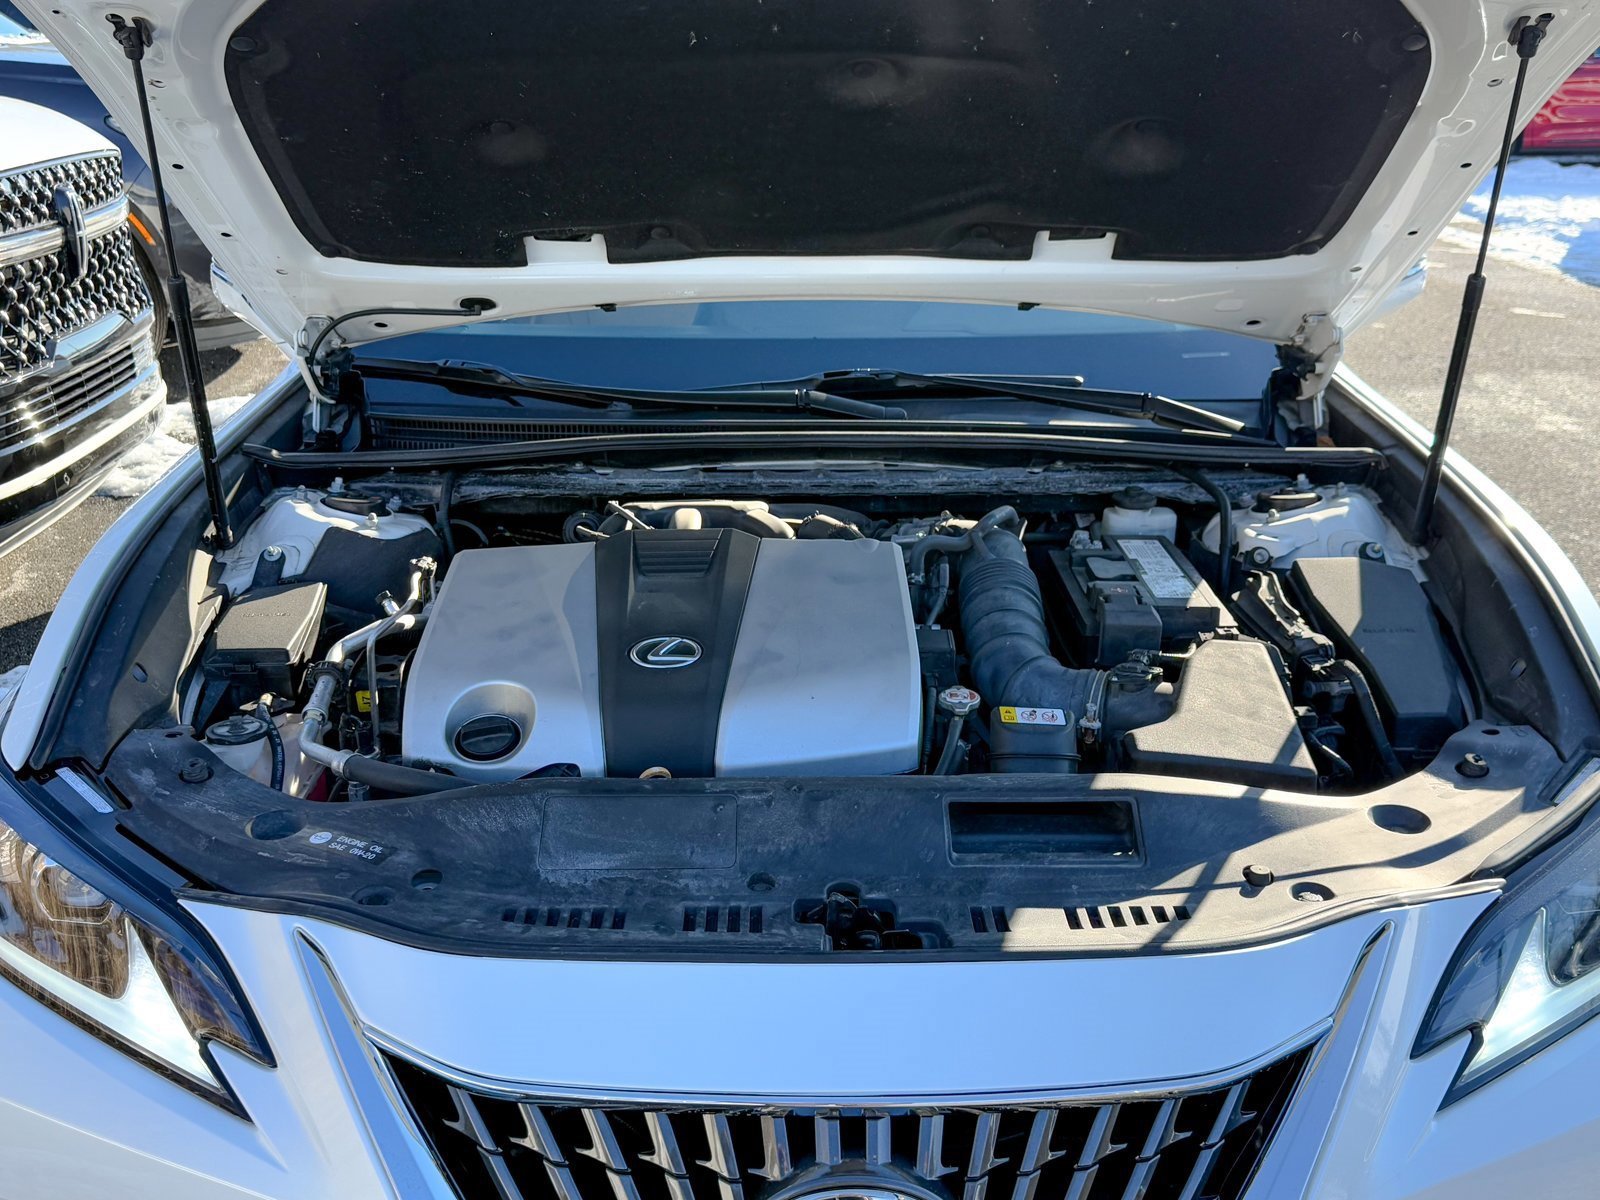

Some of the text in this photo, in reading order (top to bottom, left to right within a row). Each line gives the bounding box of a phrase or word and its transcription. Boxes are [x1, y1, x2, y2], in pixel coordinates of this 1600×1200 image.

[328, 842, 376, 860] SAE 0W-20
[336, 835, 383, 854] ENGINE OIL
